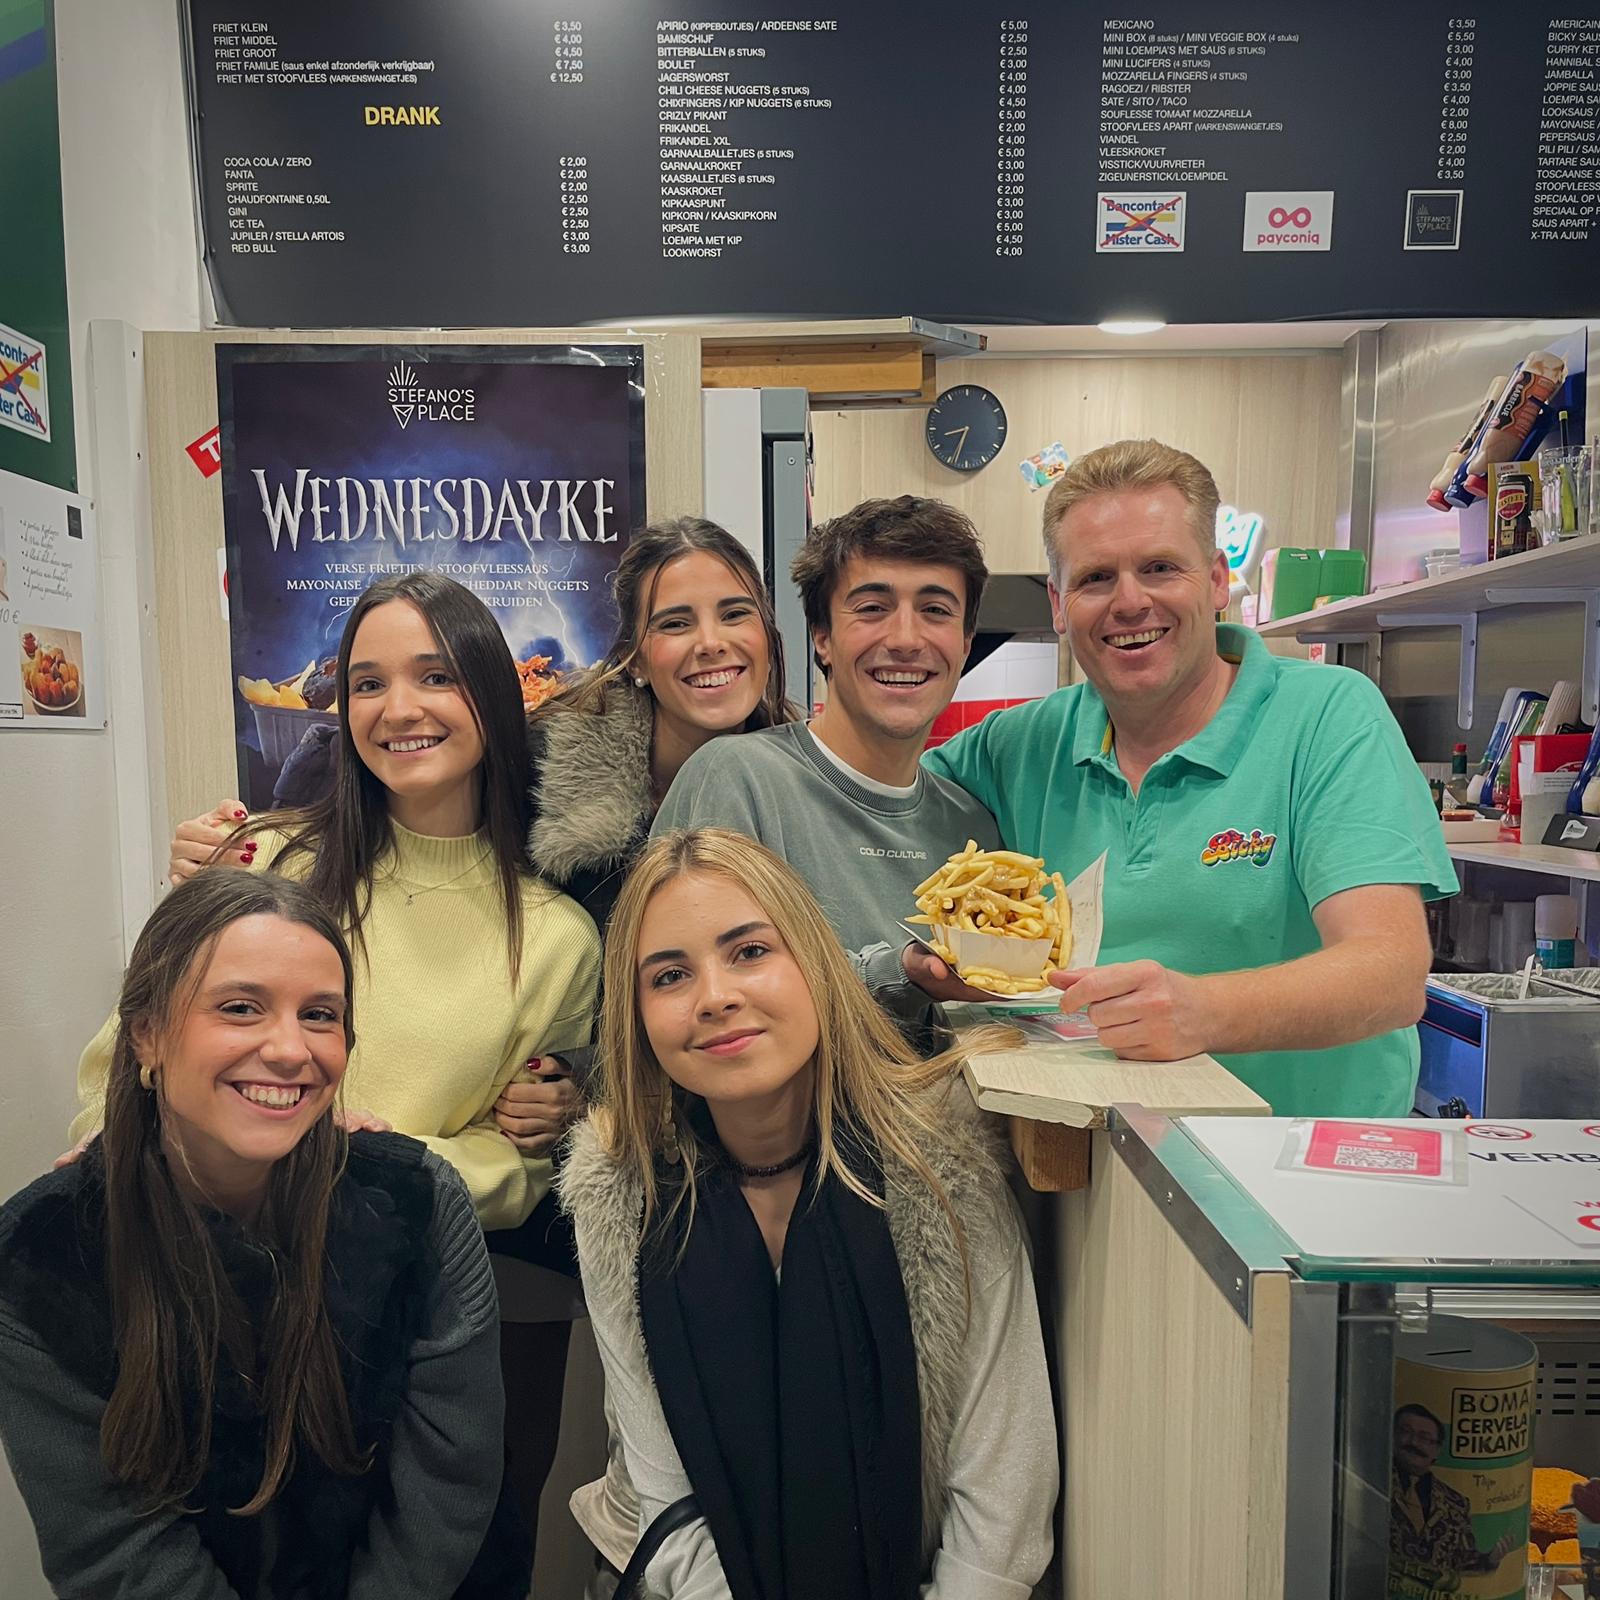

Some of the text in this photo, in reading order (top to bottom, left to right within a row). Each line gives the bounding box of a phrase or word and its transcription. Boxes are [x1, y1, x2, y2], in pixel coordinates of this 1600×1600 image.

[213, 23, 268, 32] FRIET KLEIN
[656, 21, 689, 30] APIRIO
[761, 21, 812, 31] ARDEENSE
[813, 21, 837, 30] SATE
[1104, 20, 1154, 29] MEXICANO
[214, 36, 278, 45] FRIET MIDDEL
[657, 34, 714, 44] BAMISCHIJF
[1103, 33, 1266, 42] MINI BOX MINI VEGGIE BOX
[1548, 32, 1577, 41] BICKY
[215, 48, 276, 58] FRIET GROOT
[658, 47, 726, 57] BITTERBALLEN
[1103, 46, 1226, 55] MINI LOEMPIA'S MET SAUS
[1547, 45, 1580, 54] CURRY
[216, 61, 242, 71] FRIET
[244, 61, 280, 71] FAMILIE
[331, 61, 380, 72] afzonderlijk
[382, 61, 435, 72] verkrijgbaar)
[658, 60, 696, 69] BOULET
[1102, 58, 1171, 68] MINI LUCIFERS
[1546, 58, 1593, 66] HANNIBAL
[217, 74, 242, 83] FRIET
[245, 74, 264, 83] MET
[266, 73, 327, 83] STOOFVLEES
[658, 72, 730, 82] JAGERSWORST
[1102, 71, 1208, 81] MOZZARELLA FINGERS
[1545, 70, 1594, 79] JAMBALLA
[658, 85, 771, 95] CHILI CHEESE NUGGETS
[1151, 84, 1191, 93] RIBSTER
[1544, 82, 1577, 91] JOPPIE
[658, 98, 793, 108] CHIXFINGERS KIP NUGGETS
[1101, 97, 1187, 106] SATE SITO TACO
[1543, 95, 1584, 104] LOEMPIA
[365, 106, 441, 125] DRANK
[693, 111, 727, 120] PIKANT
[1155, 110, 1191, 118] TOMAAT
[1193, 109, 1252, 118] MOZZARELLA
[1542, 107, 1593, 116] LOOKSAUS
[659, 124, 712, 133] FRIKANDEL
[1100, 122, 1161, 131] STOOFVLEES
[1162, 122, 1193, 131] APART
[1541, 120, 1595, 129] MAYONAISE
[660, 136, 731, 146] FRIKANDEL XXL
[1100, 135, 1139, 144] VIANDEL
[1539, 132, 1595, 141] PEPERSAUS
[660, 149, 755, 158] GARNAALBALLETJES
[1099, 147, 1166, 157] VLEESKROKET
[1538, 145, 1574, 154] PILI PILI
[224, 157, 312, 167] COCA COLA ZERO
[660, 161, 742, 171] GARNAALKROKET
[1538, 157, 1578, 166] TARTARE
[225, 170, 254, 179] FANTA
[1537, 169, 1593, 178] TOSCAANSE
[661, 174, 736, 183] KAASBALLETJES
[226, 182, 259, 191] SPRITE
[661, 186, 723, 196] KAASKROKET
[227, 194, 331, 205] CHAUDFONTAINE 0,50L
[1534, 194, 1595, 203] SPECIAAL OP
[661, 199, 726, 208] KIPKAASPUNT
[1106, 199, 1176, 212] Bancontact
[228, 207, 248, 216] GINI
[1533, 206, 1594, 215] SPECIAAL OP
[662, 211, 777, 221] KIPKORN KAASKIPKORN
[229, 219, 265, 228] ICE TEA
[662, 223, 700, 233] KIPSATE
[1532, 219, 1589, 228] SAUS APART
[230, 231, 345, 241] JUPILER STELLA ARTOIS
[1257, 231, 1320, 245] payconiq
[1530, 231, 1588, 240] X-TRA AJUIN
[662, 236, 742, 245] LOEMPIA MET KIP
[231, 244, 277, 253] RED BULL
[663, 248, 722, 257] LOOKWORST
[388, 388, 475, 403] STEFANO'S
[417, 404, 475, 421] PLACE
[251, 468, 618, 552] WEDNESDAYKE
[325, 563, 365, 574] VERSE
[437, 563, 549, 574] STOOFVLEESSAUS
[286, 580, 362, 590] MAYONAISE
[527, 580, 589, 591] NUGGETS
[1201, 828, 1276, 868] Bicky
[859, 847, 928, 860] COLD CULTURE
[1456, 1429, 1528, 1454] PIKANT
